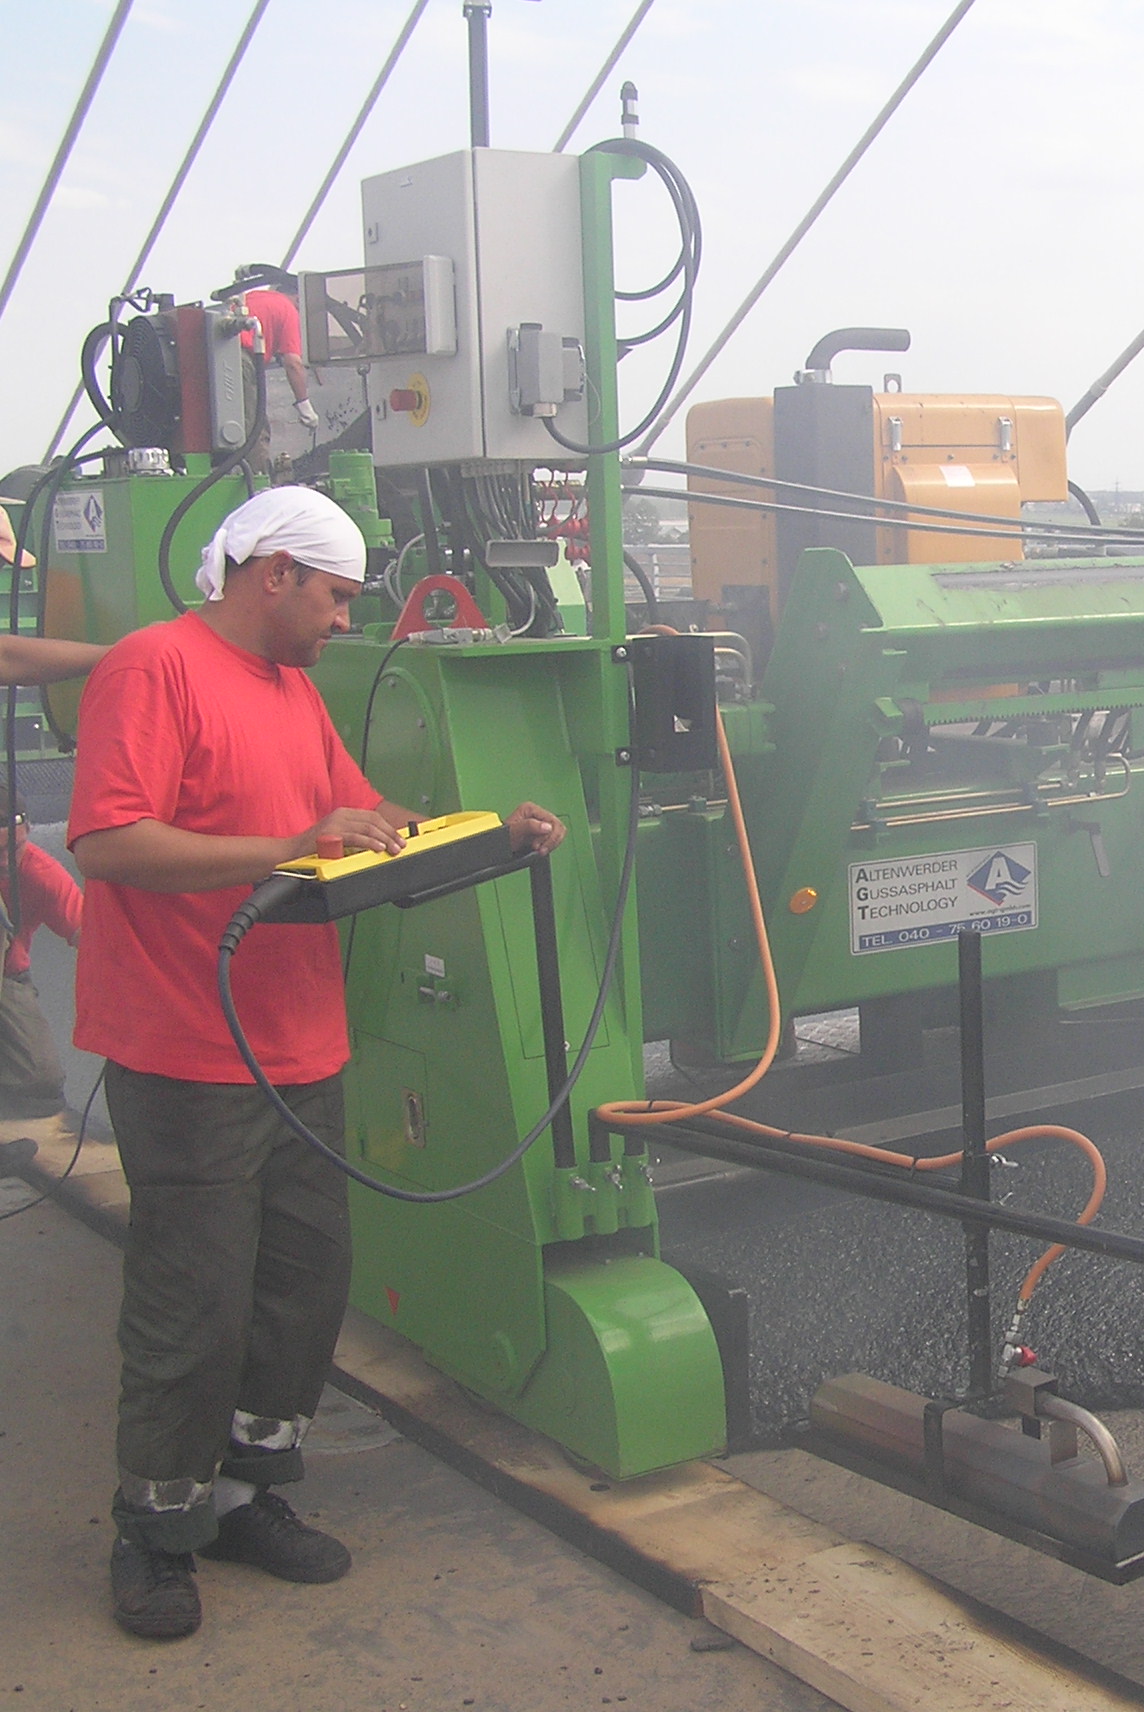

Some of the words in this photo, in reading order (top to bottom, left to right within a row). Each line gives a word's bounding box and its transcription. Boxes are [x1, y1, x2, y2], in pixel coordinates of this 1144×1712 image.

[855, 859, 958, 883] ALTENWERDER
[856, 878, 958, 902] GUSSASPHALT
[857, 896, 959, 920] TECHNOLOGY
[899, 928, 930, 942] 040
[972, 919, 991, 932] 60
